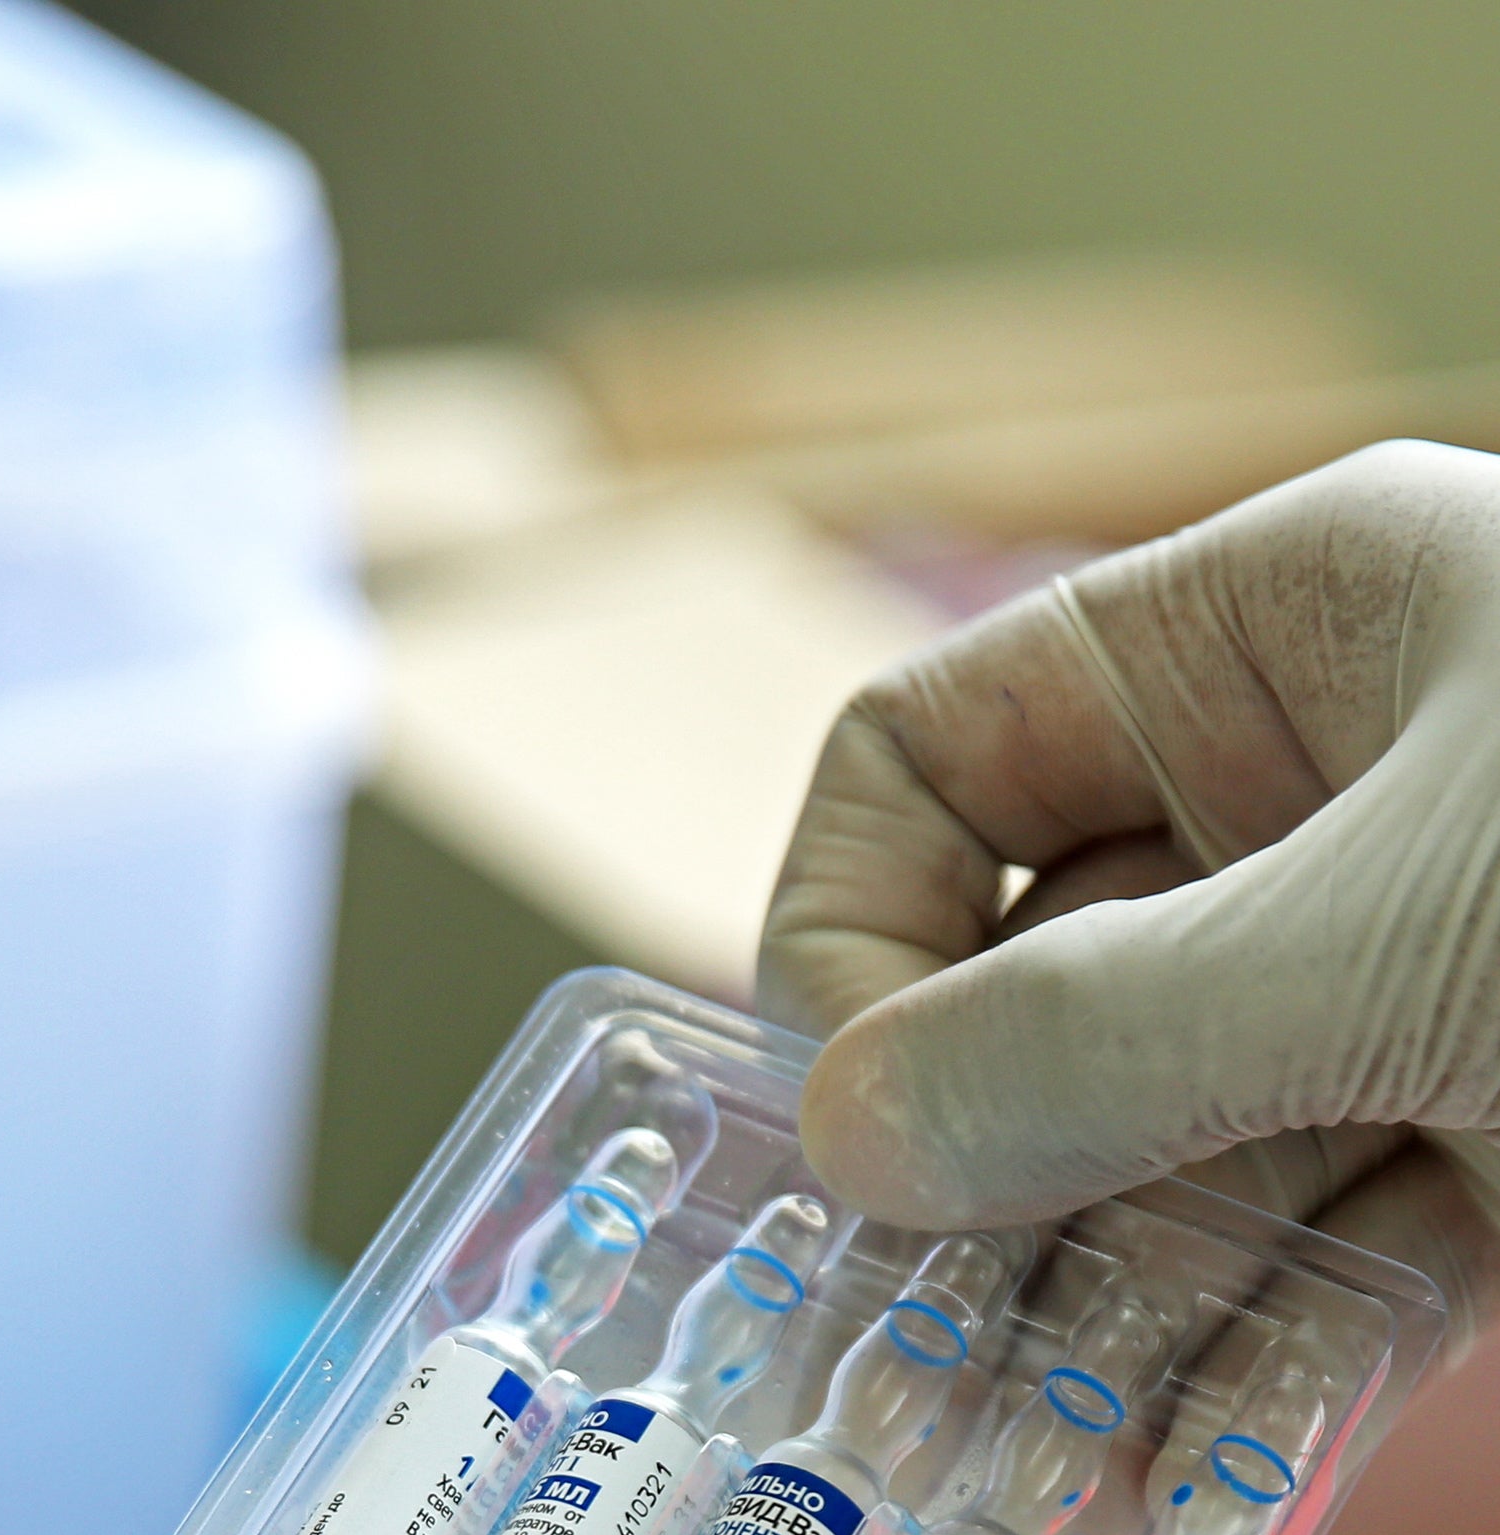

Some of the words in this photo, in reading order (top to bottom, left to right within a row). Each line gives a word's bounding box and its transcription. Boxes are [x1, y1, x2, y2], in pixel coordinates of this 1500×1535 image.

[386, 1402, 409, 1425] 09
[411, 1367, 437, 1389] 21
[328, 1493, 346, 1513] до
[544, 1481, 590, 1505] мл
[417, 1508, 436, 1529] не
[564, 1510, 586, 1524] от
